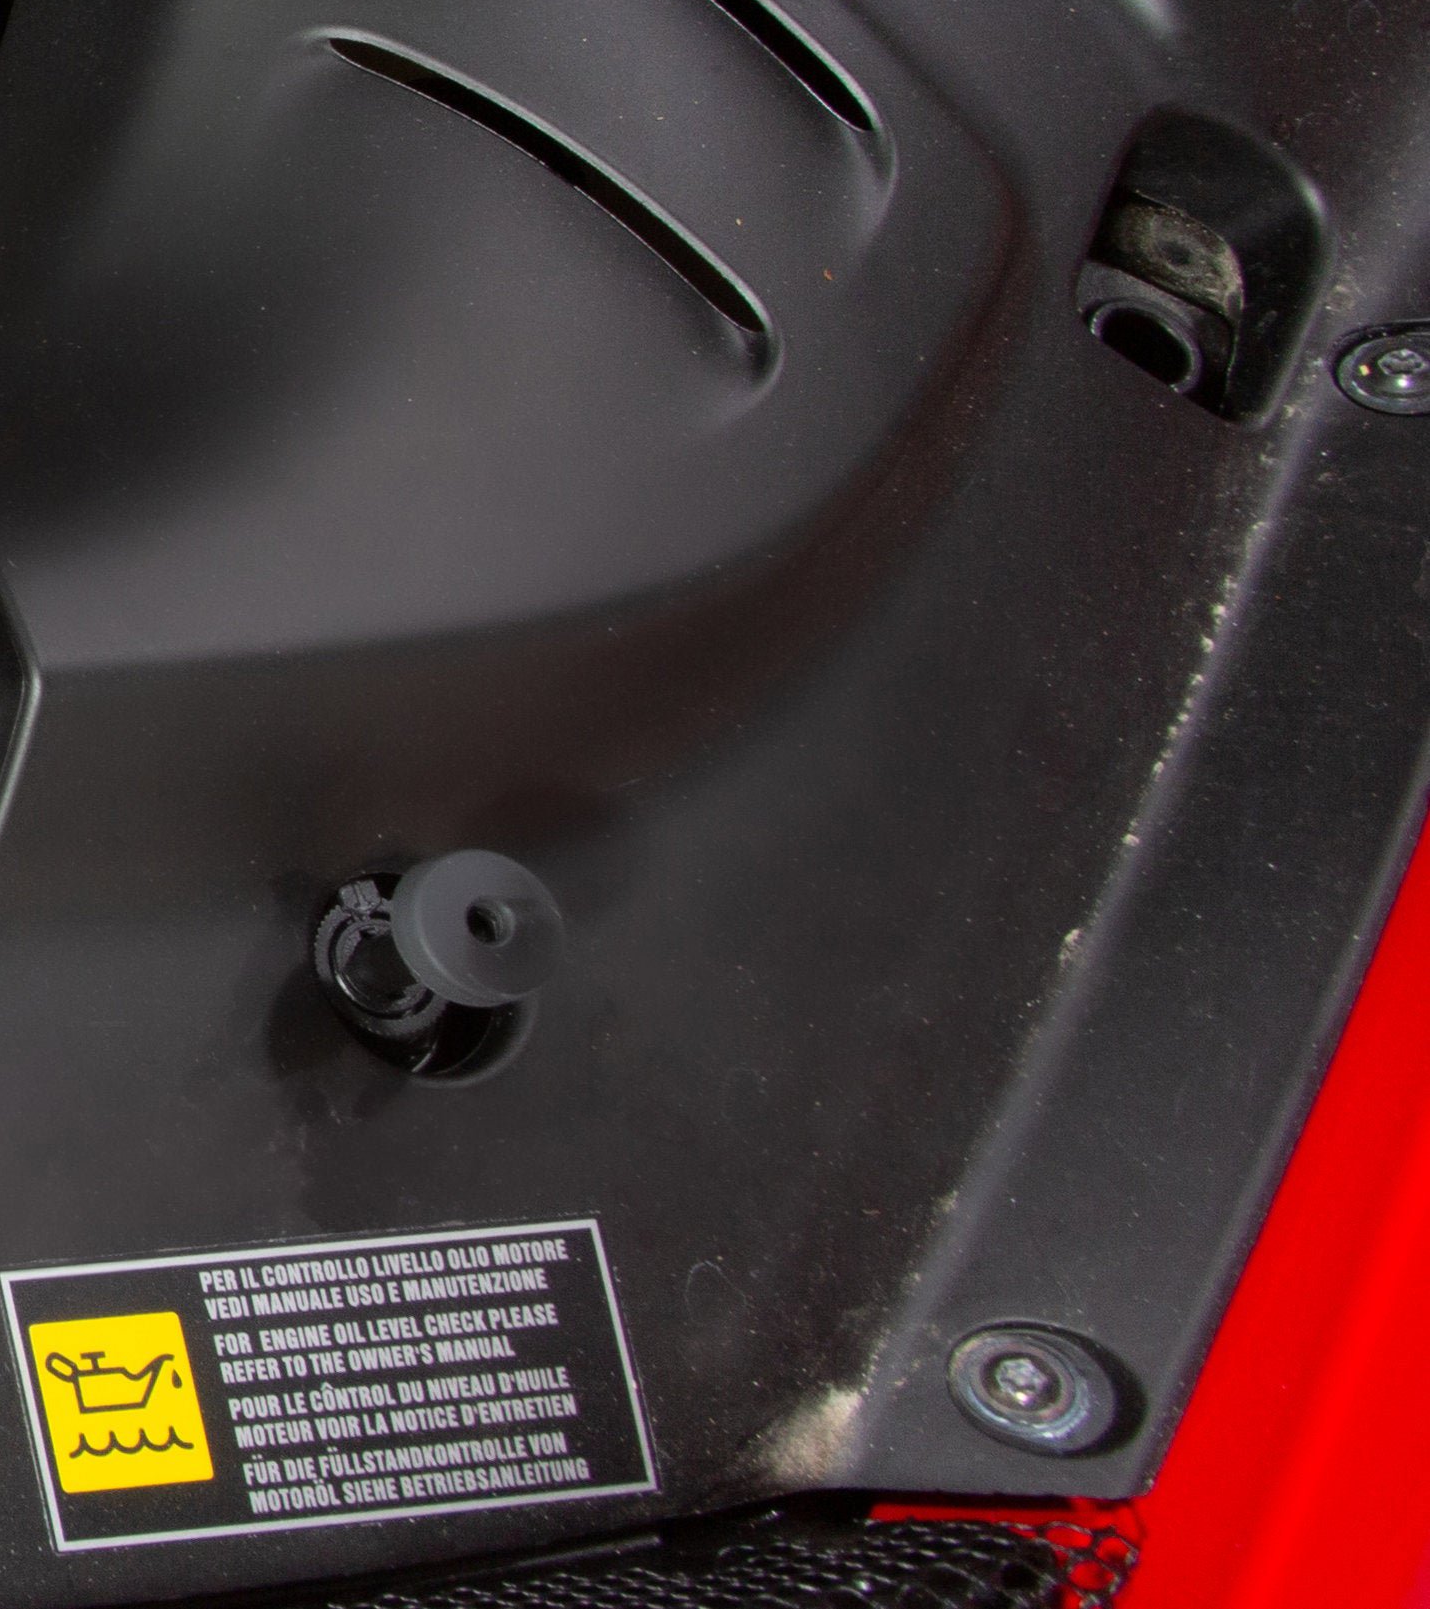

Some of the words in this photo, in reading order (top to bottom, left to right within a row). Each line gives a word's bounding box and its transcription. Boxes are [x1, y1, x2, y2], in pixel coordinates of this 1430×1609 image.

[200, 1270, 237, 1292] PER
[240, 1268, 260, 1289] IL
[262, 1257, 369, 1286] CONTROLLO
[372, 1251, 444, 1276] LIVELLO
[447, 1246, 489, 1269] OLIO
[492, 1239, 567, 1265] MOTORE
[205, 1296, 249, 1319] VEDI
[252, 1288, 343, 1315] MANUALE
[346, 1284, 384, 1307] USO
[387, 1282, 400, 1302] E
[402, 1269, 547, 1301] MANUTENZIONE
[214, 1333, 252, 1355] FOR
[260, 1325, 331, 1351] ENGINE
[334, 1322, 365, 1344] OIL
[367, 1317, 422, 1341] LEVEL
[425, 1311, 487, 1335] CHECK
[488, 1304, 557, 1329] PLEASE
[220, 1358, 280, 1383] REFER
[282, 1355, 307, 1377] TO
[309, 1351, 345, 1374] THE
[348, 1344, 433, 1371] OWNER'S
[436, 1336, 514, 1362] MANUAL
[229, 1395, 281, 1420] POUR
[284, 1392, 307, 1414] LE
[398, 1381, 424, 1403] DU
[427, 1374, 495, 1400] NIVEAU
[498, 1367, 569, 1393] D'HUILE
[235, 1420, 313, 1447] MOTEUR
[315, 1416, 360, 1439] VOIR
[363, 1413, 389, 1435] LA
[390, 1406, 458, 1432] NOTICE
[460, 1395, 576, 1425] D'ENTRETIEN
[243, 1455, 282, 1485] FÜR
[284, 1458, 316, 1480] DIE
[318, 1436, 527, 1477] FÜLLSTANDKONTROLLE
[528, 1432, 566, 1455] VON
[249, 1478, 341, 1513] MOTORÖL
[343, 1478, 398, 1503] SIEHE
[400, 1458, 589, 1497] BETRIEBSANLEITUNG
